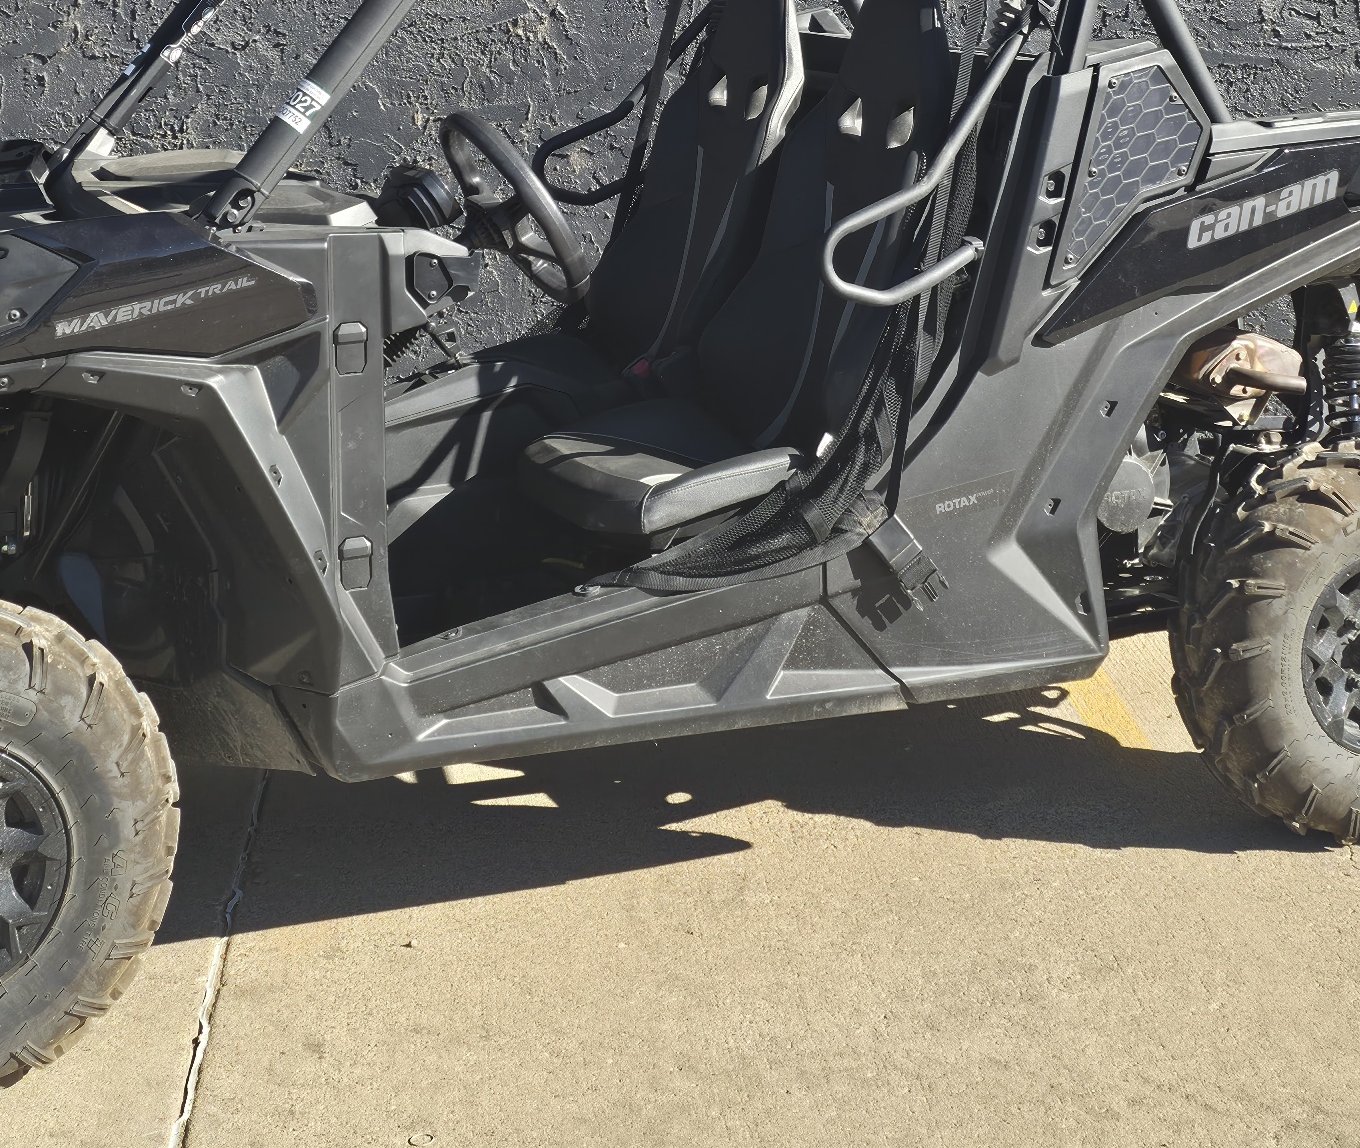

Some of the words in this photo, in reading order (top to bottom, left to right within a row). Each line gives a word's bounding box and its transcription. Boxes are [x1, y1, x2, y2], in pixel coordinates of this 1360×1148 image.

[285, 88, 322, 117] 027
[1188, 169, 1339, 249] can-am
[55, 289, 195, 338] MAVERICK
[196, 275, 257, 298] TRAIL
[936, 494, 978, 514] ROTAX
